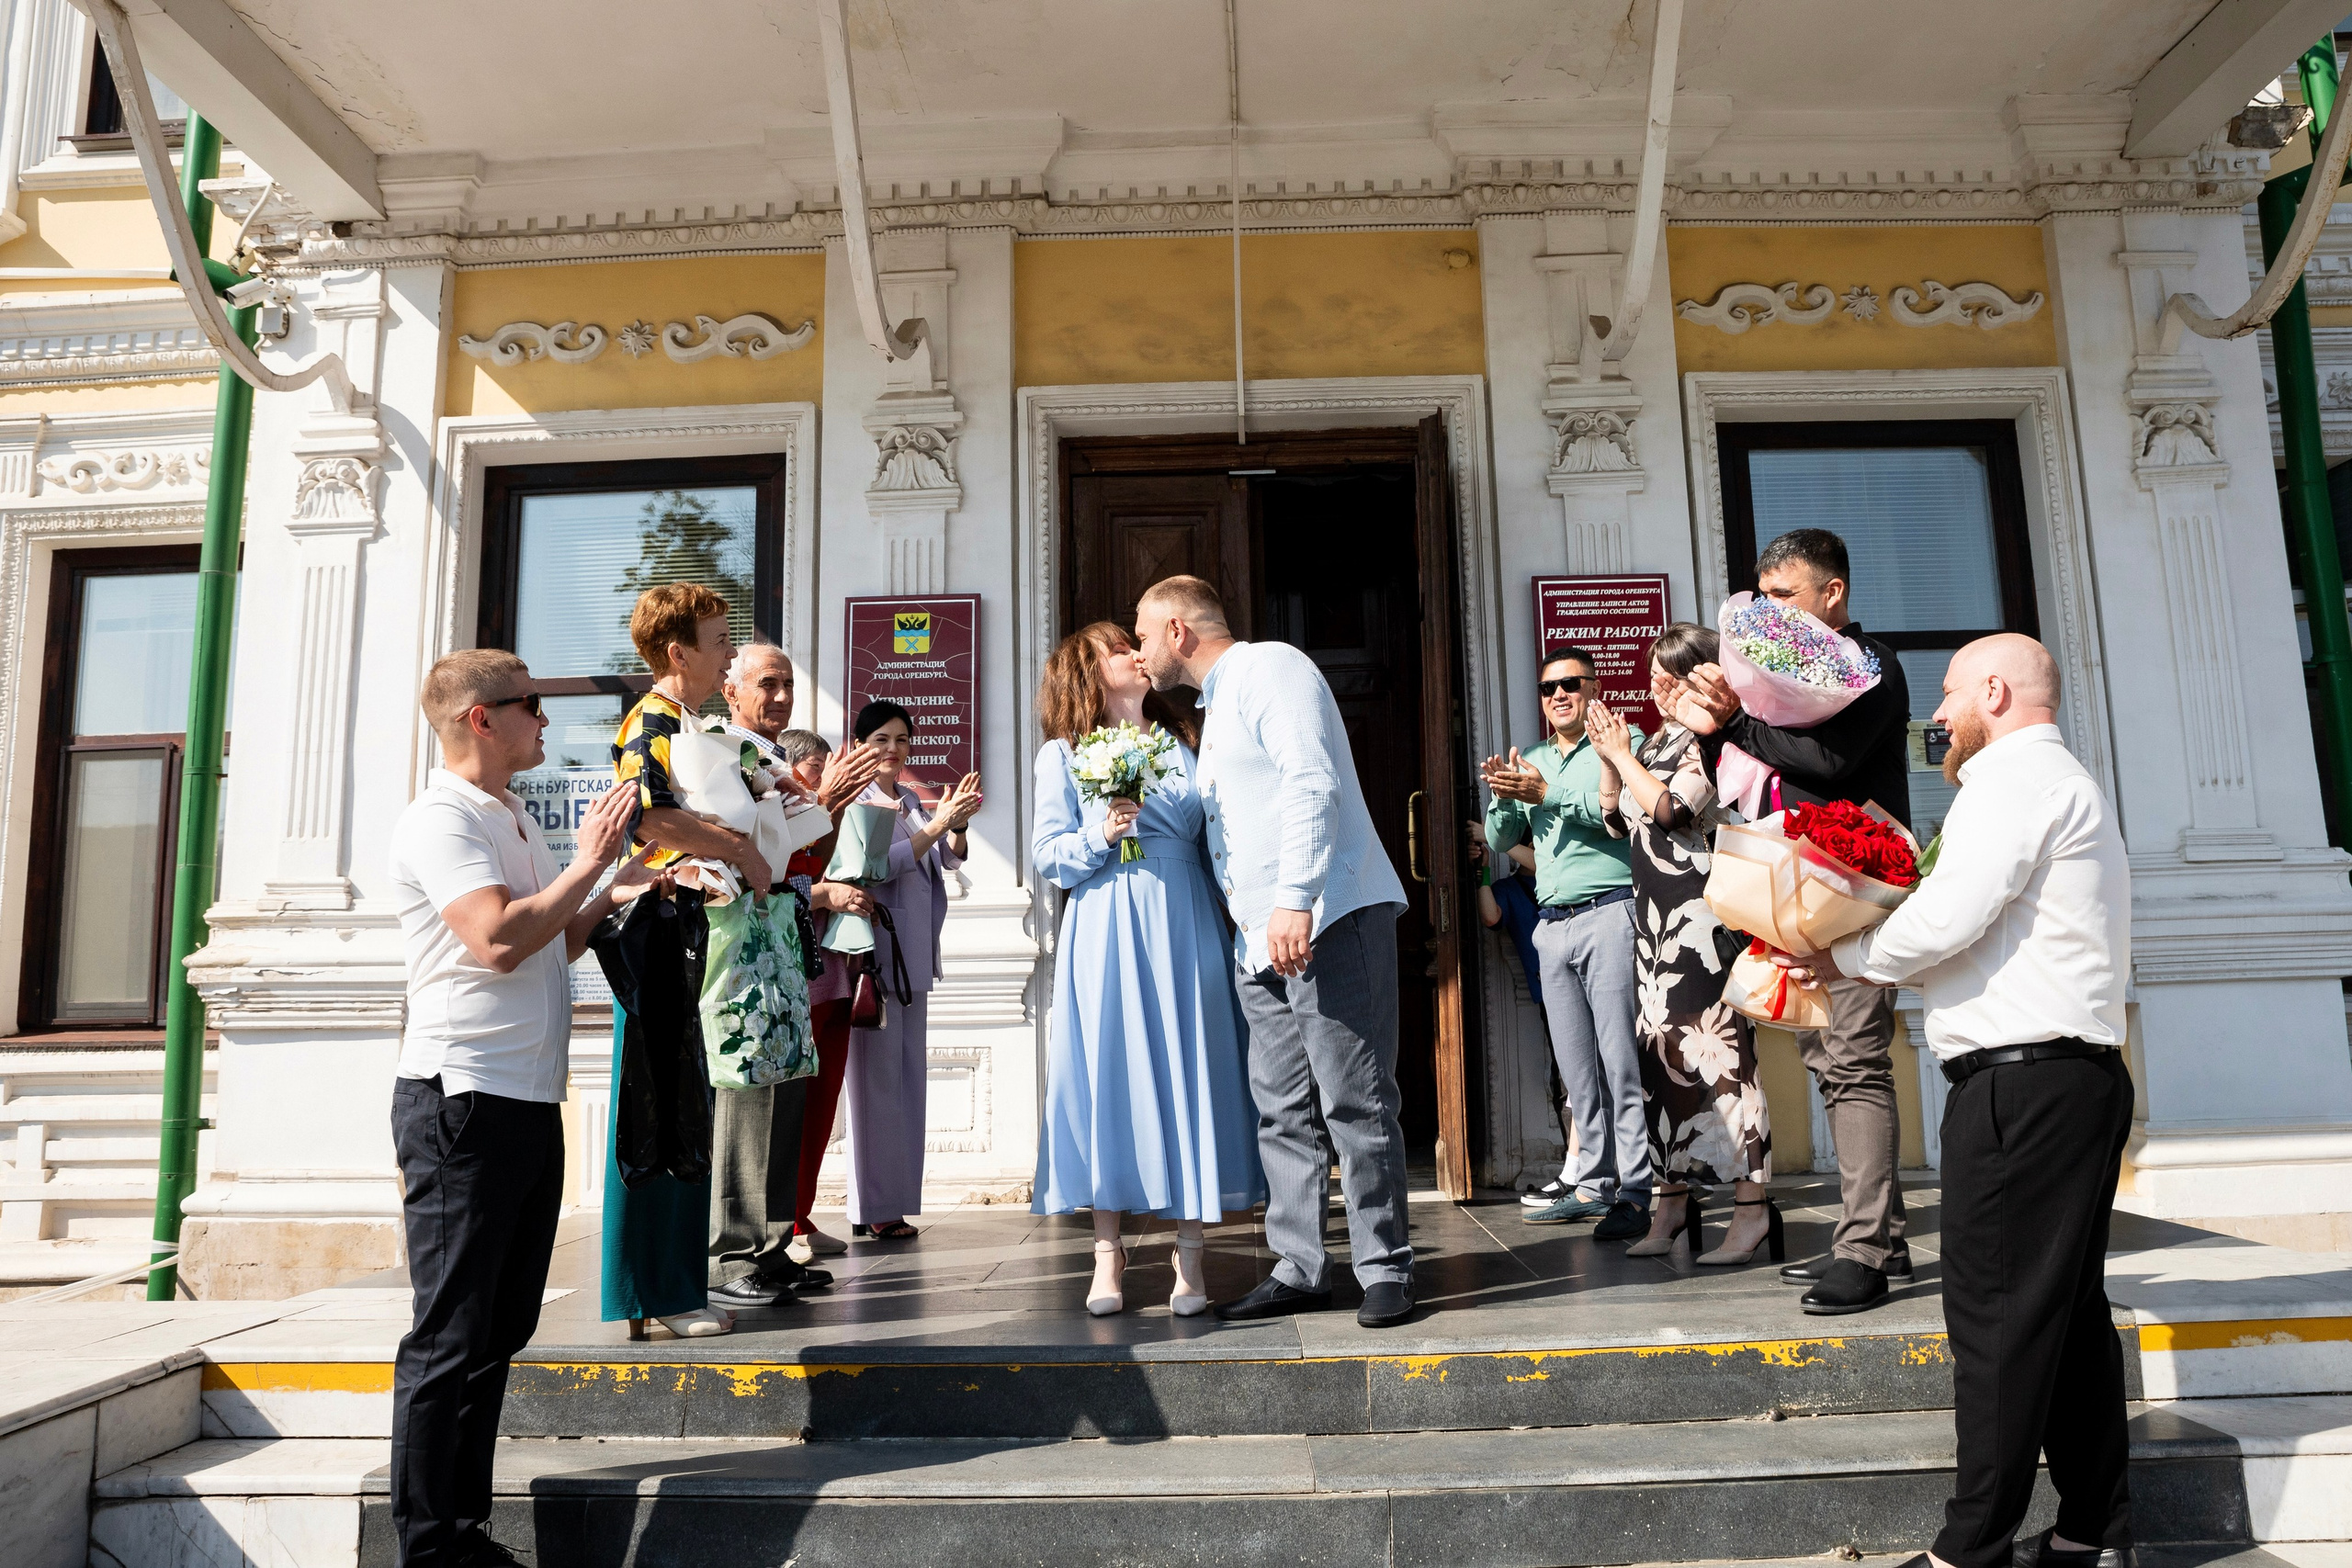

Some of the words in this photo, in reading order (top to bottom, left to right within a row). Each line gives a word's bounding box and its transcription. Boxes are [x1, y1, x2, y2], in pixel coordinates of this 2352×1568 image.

[1545, 627, 1601, 639] РЕЖИМ
[1603, 626, 1663, 637] РАБОТЫ
[876, 661, 945, 670] АДМИНИСТРАЦИЯ
[904, 671, 948, 679] ОРЕНБУРГА
[918, 715, 960, 726] актов
